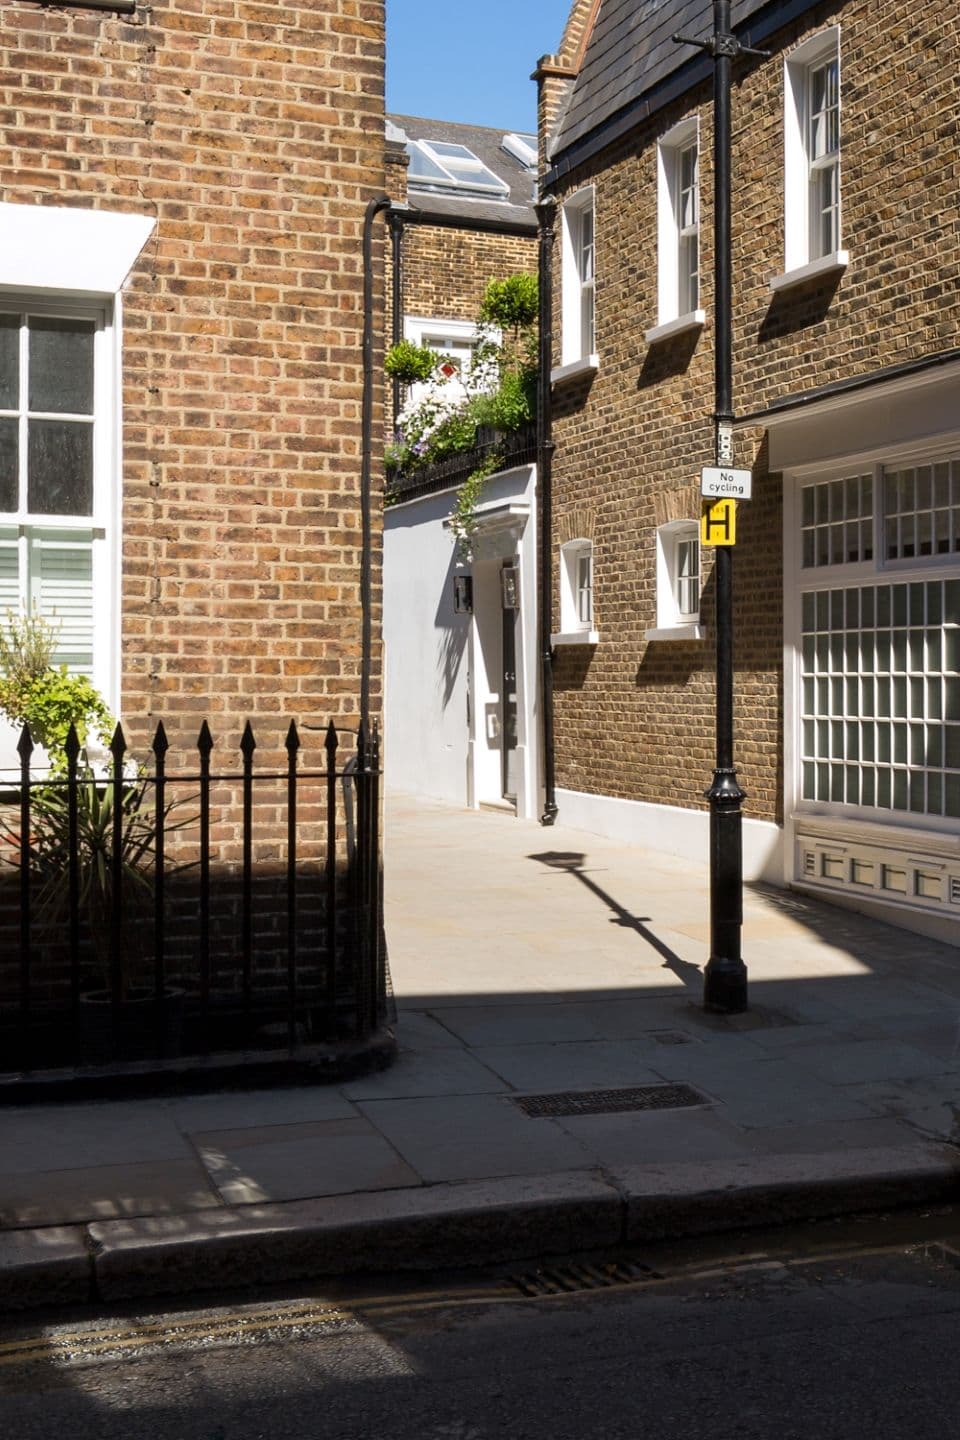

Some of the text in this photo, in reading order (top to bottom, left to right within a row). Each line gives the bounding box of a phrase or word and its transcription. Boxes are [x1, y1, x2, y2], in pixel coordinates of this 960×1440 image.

[720, 472, 734, 482] No
[709, 483, 744, 494] cycling
[706, 505, 730, 540] H
